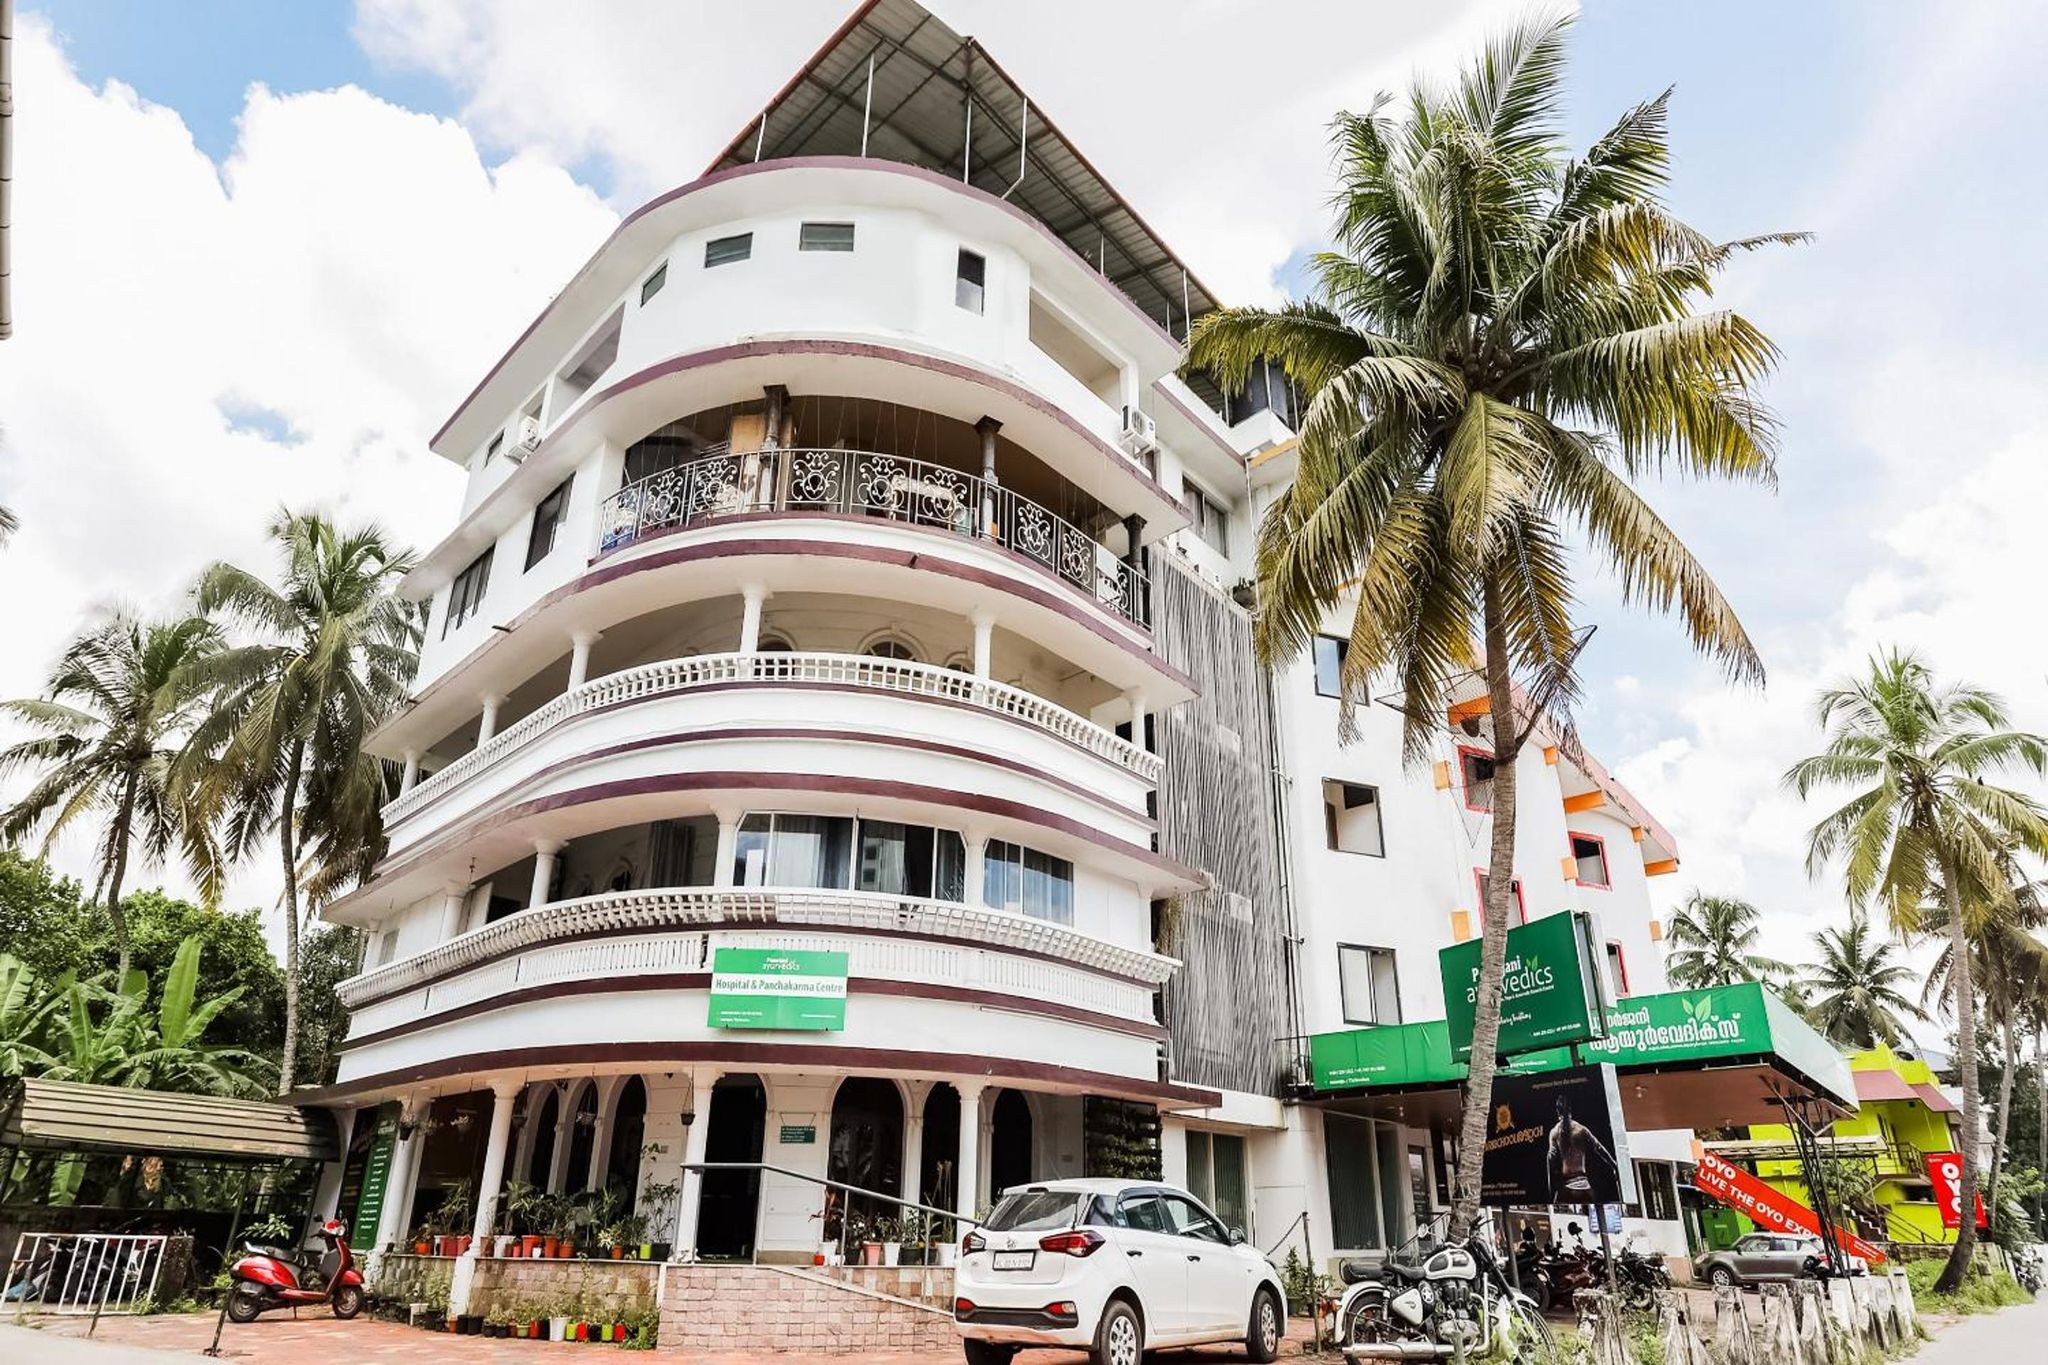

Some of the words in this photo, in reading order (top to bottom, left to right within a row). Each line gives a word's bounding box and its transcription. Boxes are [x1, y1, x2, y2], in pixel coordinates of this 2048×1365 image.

[716, 979, 749, 990] Hospital
[750, 980, 757, 989] &
[759, 980, 815, 992] Panchakarma
[816, 982, 843, 993] Centre
[1466, 966, 1553, 1003] avedics
[1705, 1155, 1736, 1180] OYO
[1700, 1168, 1728, 1191] LIVE
[1729, 1185, 1755, 1207] THE
[1756, 1203, 1784, 1223] OYO
[1785, 1218, 1815, 1237] EXP
[1941, 1162, 1961, 1214] OYO
